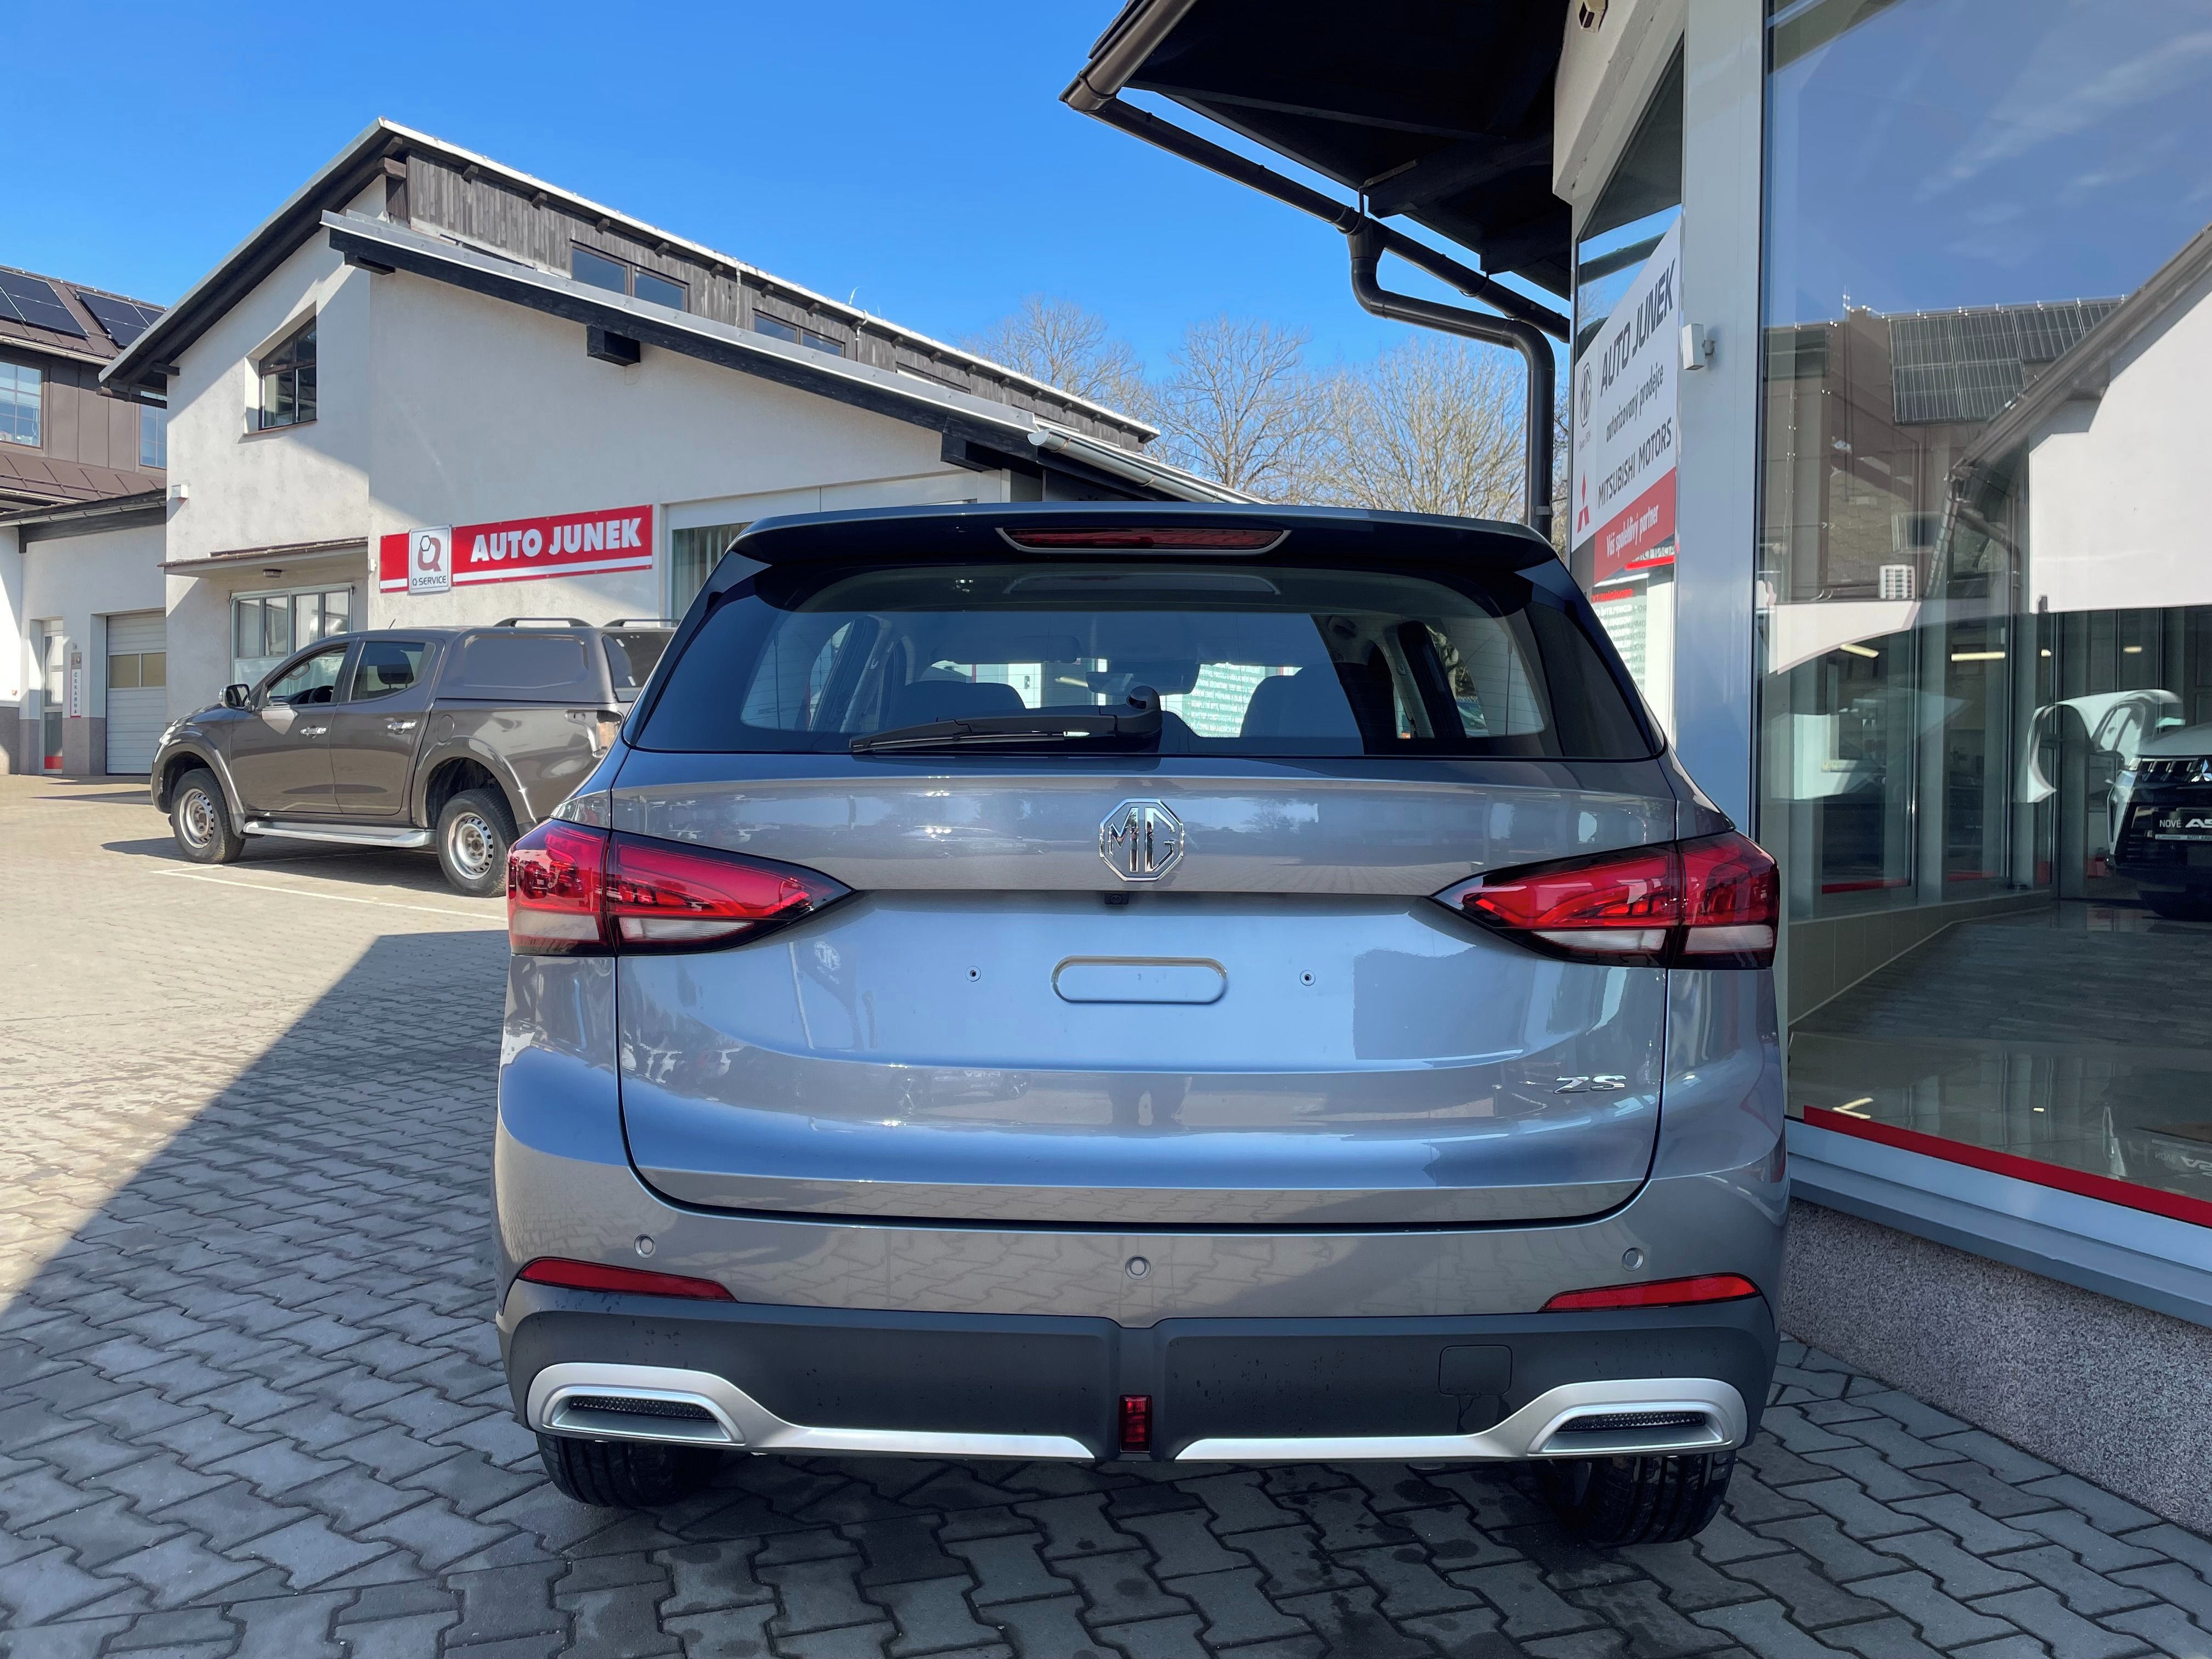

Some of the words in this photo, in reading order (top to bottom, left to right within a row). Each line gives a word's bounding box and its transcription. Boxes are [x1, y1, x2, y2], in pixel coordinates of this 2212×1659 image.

[1600, 321, 1630, 397] AUTO
[1632, 258, 1675, 358] JUNEK
[1606, 385, 1638, 443] autorizovaný
[1640, 362, 1663, 416] prodejce
[1599, 452, 1635, 509] MITSUBISHI
[1639, 417, 1671, 473] MOTORS
[470, 529, 543, 563] AUTO
[548, 517, 642, 555] JUNEK
[1606, 531, 1615, 557] Váš
[1616, 512, 1639, 557] spolehlivý
[1640, 504, 1659, 543] partner
[419, 575, 447, 586] SERVICE
[1108, 806, 1176, 873] MG
[2159, 817, 2181, 828] NOVÉ
[1553, 1075, 1627, 1094] ZS
